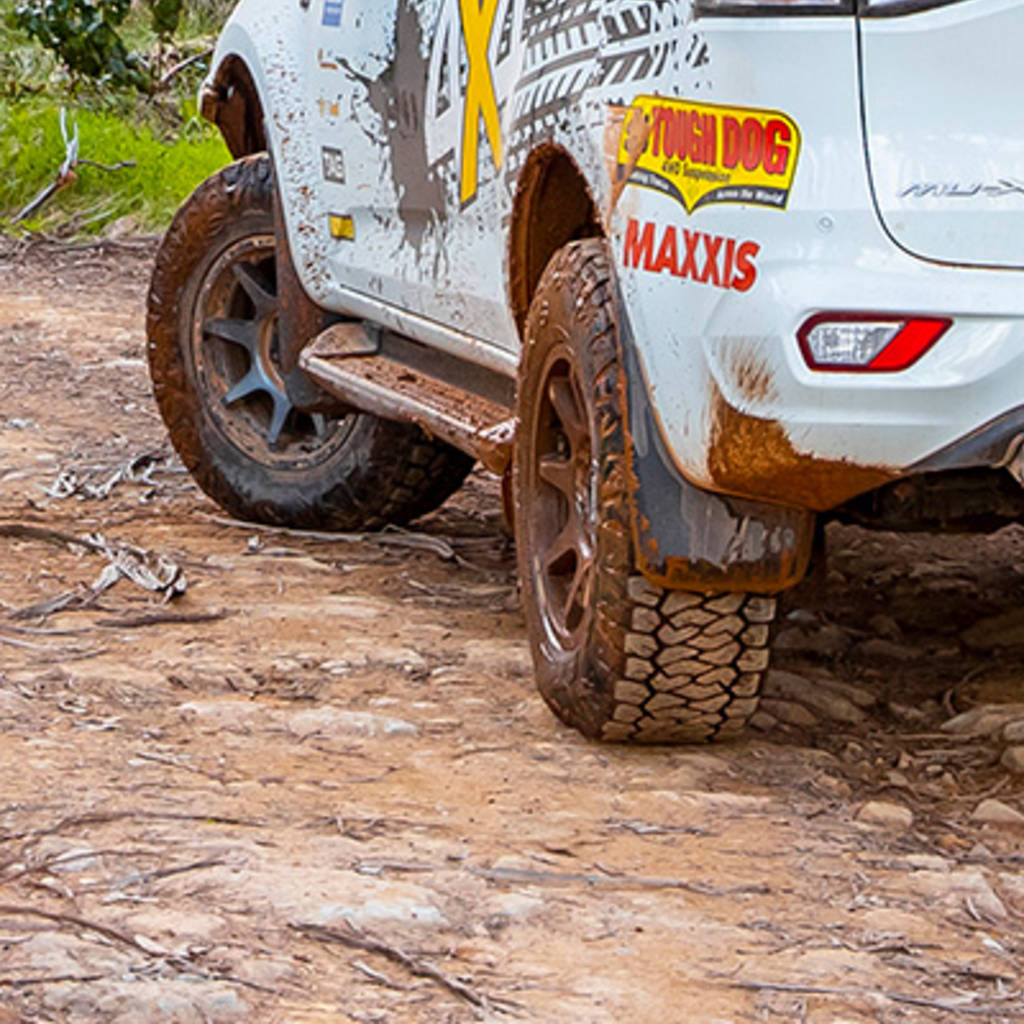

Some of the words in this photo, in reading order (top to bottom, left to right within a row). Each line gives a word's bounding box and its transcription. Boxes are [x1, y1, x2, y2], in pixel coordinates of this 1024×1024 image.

[652, 106, 717, 166] TOUGH
[721, 115, 791, 175] DOG
[622, 218, 761, 293] MAXXIS
